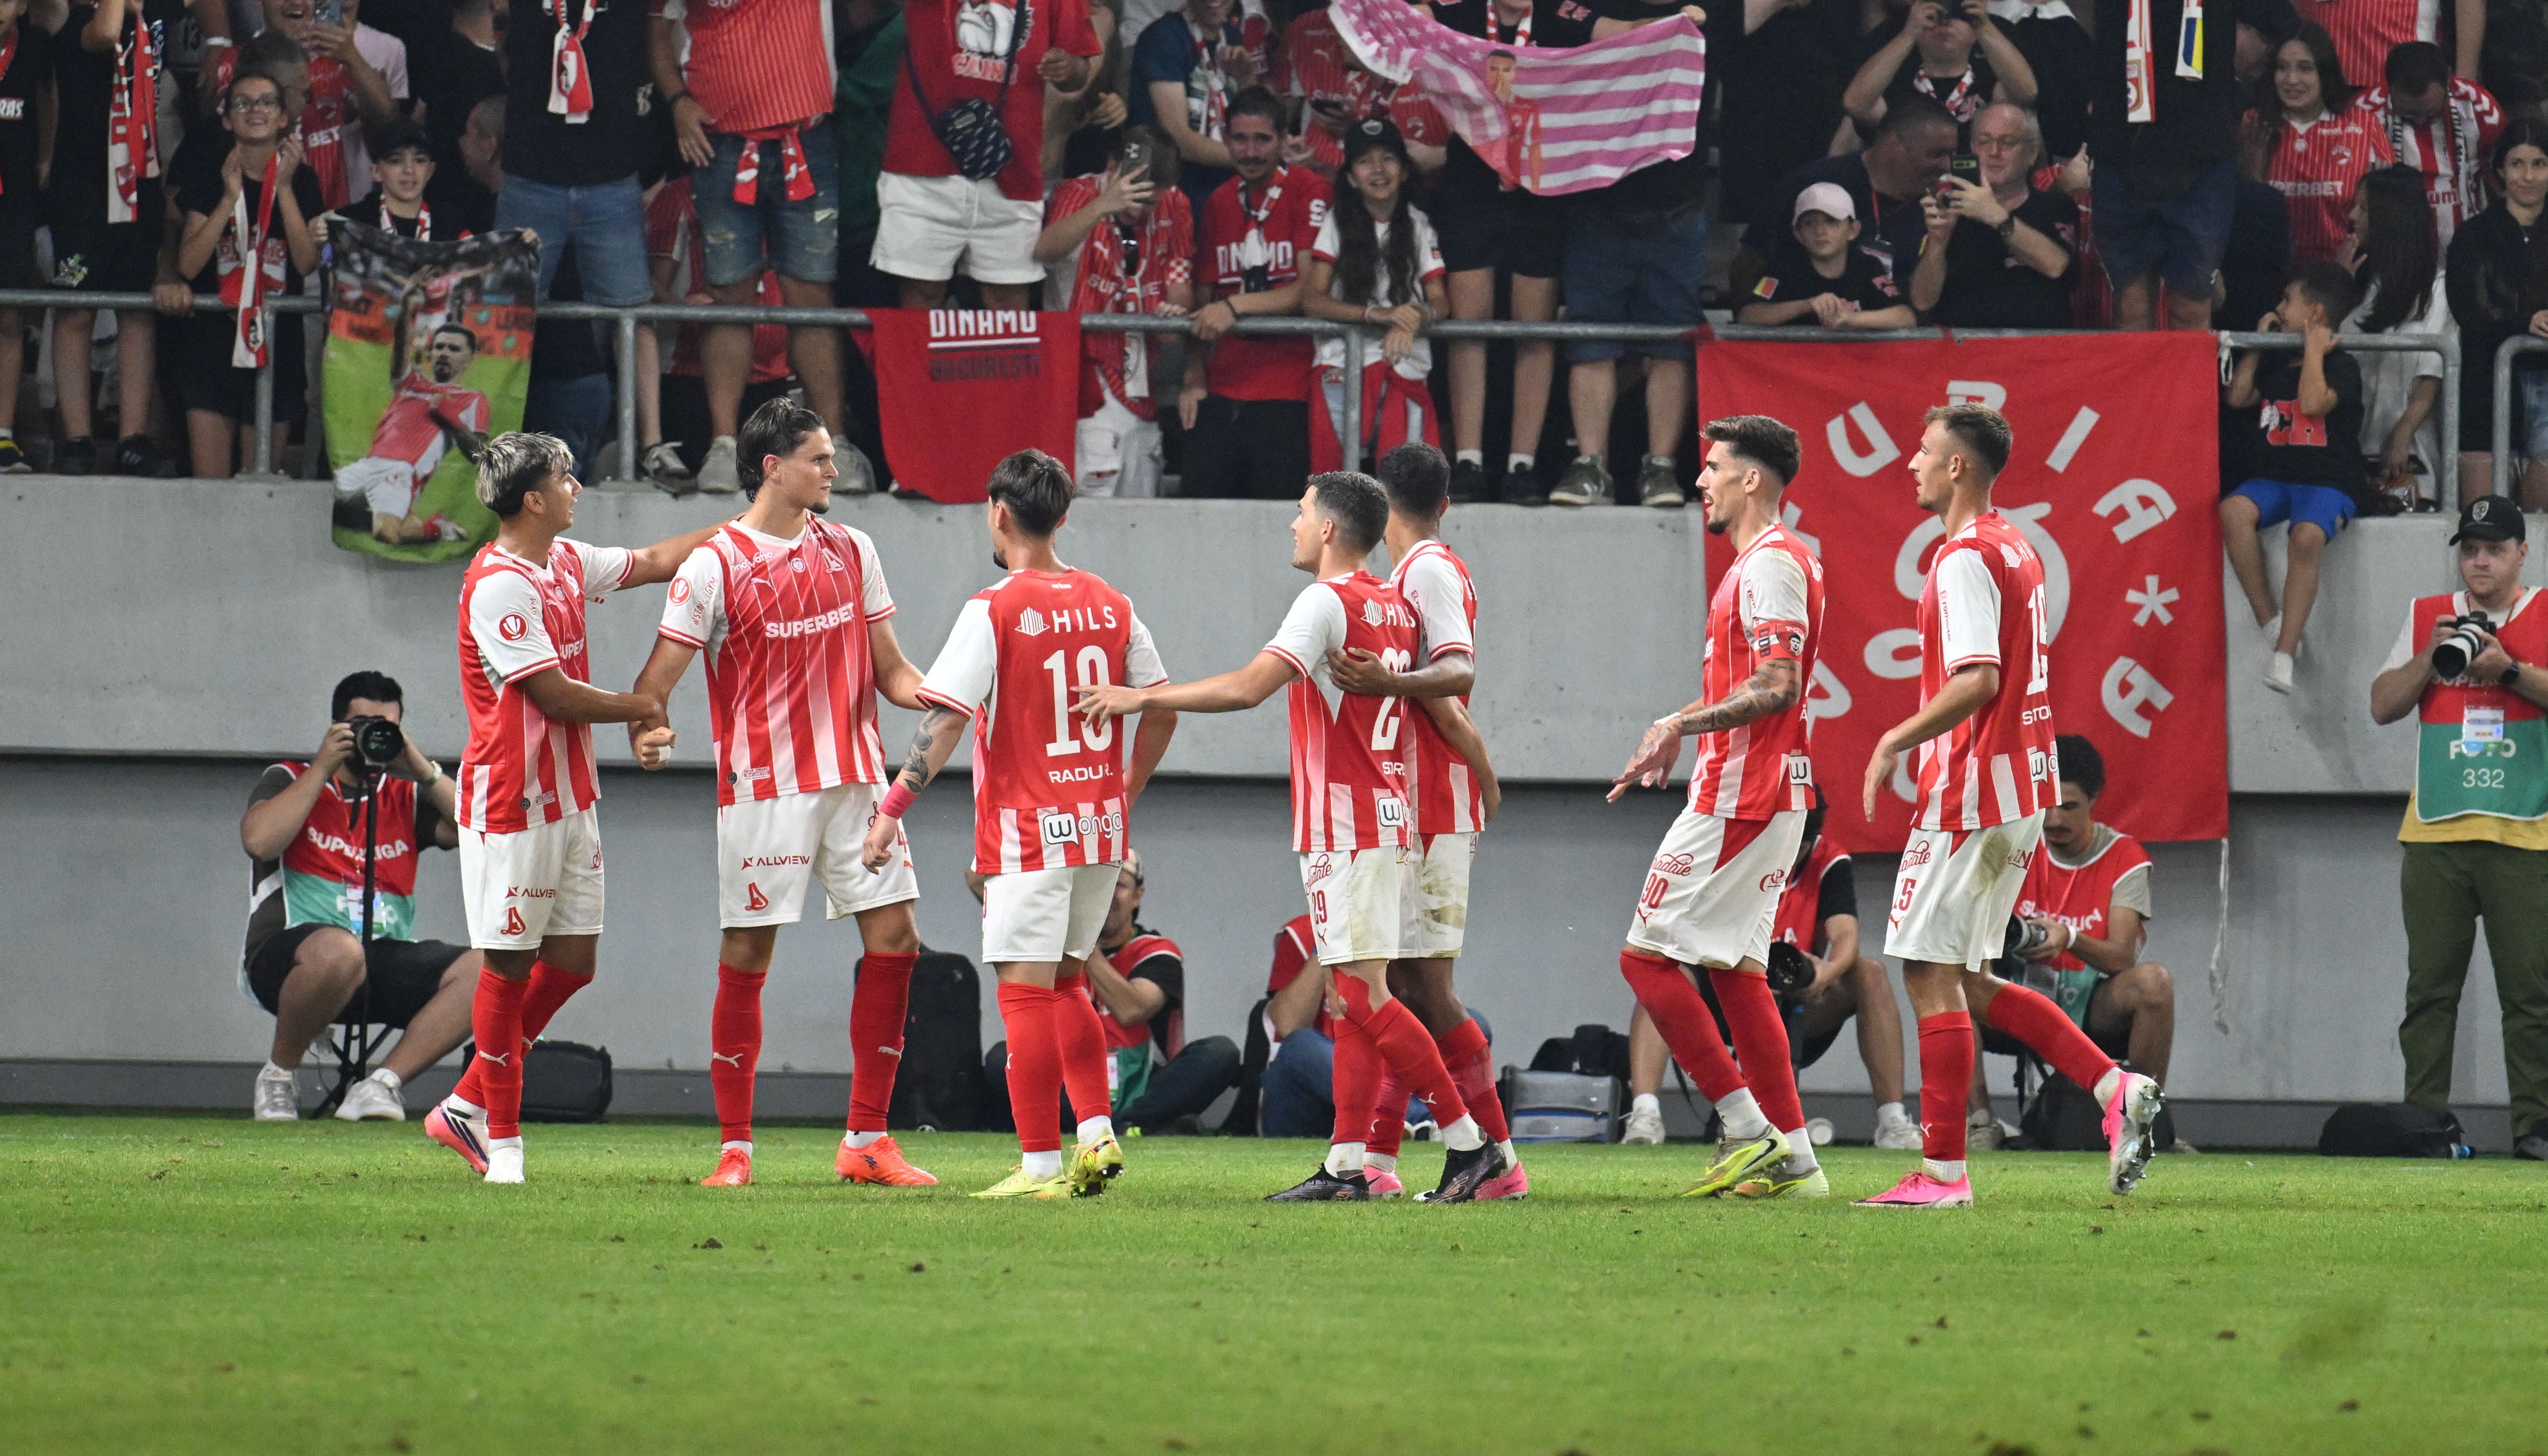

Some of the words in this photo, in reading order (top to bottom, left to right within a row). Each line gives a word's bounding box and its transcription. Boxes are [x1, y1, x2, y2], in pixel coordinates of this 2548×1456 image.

[705, 576, 718, 595] GYM
[765, 603, 855, 639] SUPERBET
[1052, 606, 1117, 633] HILS
[2450, 739, 2516, 759] FO
[1048, 765, 1103, 783] RADU
[2462, 768, 2505, 789] 332
[1046, 812, 1123, 842] wonga
[308, 826, 409, 862] SUPERIGA
[757, 855, 810, 867] ALLVIEW
[1641, 872, 1669, 909] 90
[336, 895, 398, 924] FO
[1312, 889, 1328, 925] 29
